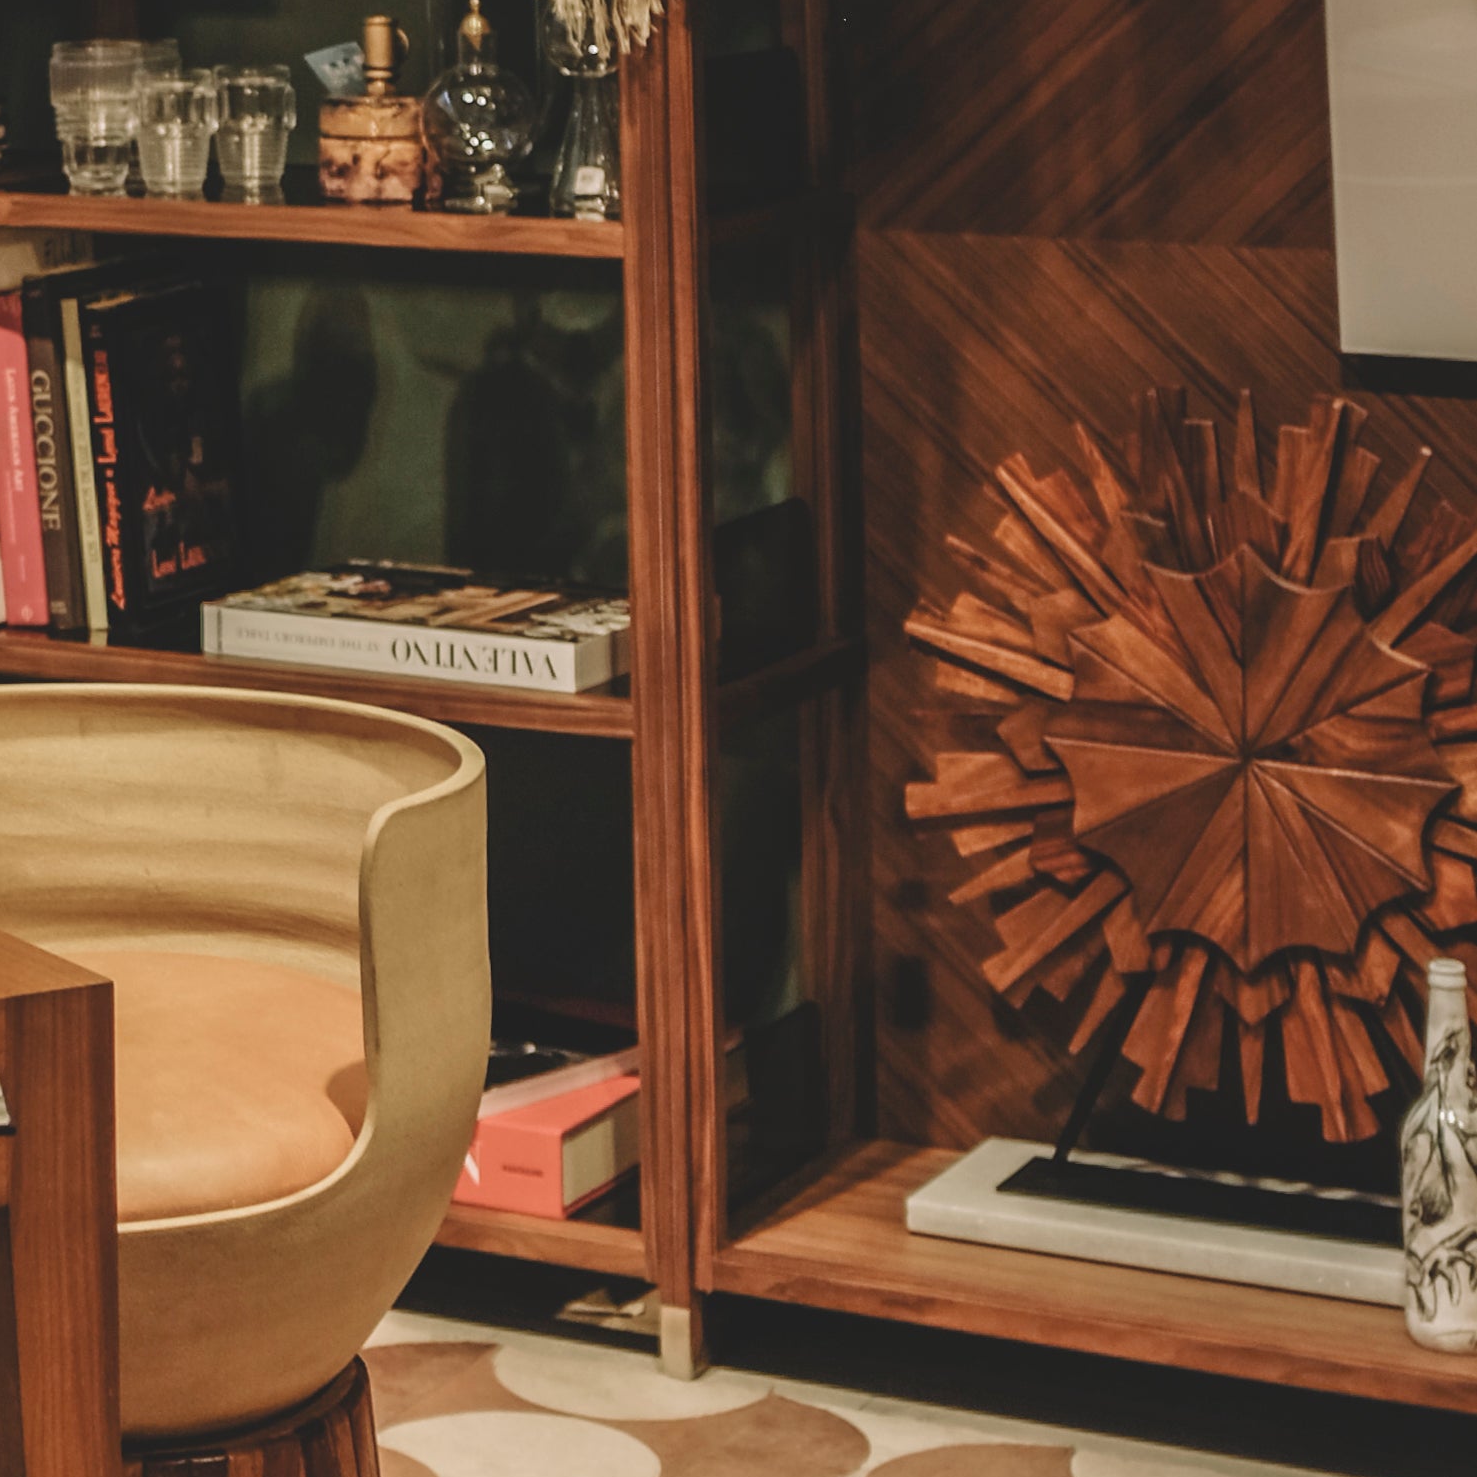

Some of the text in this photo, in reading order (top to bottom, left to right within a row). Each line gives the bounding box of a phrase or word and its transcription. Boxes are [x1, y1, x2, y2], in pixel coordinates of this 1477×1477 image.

[29, 369, 61, 532] GUCCIONE
[339, 639, 362, 652] THE
[390, 636, 558, 681] VALENTINO
